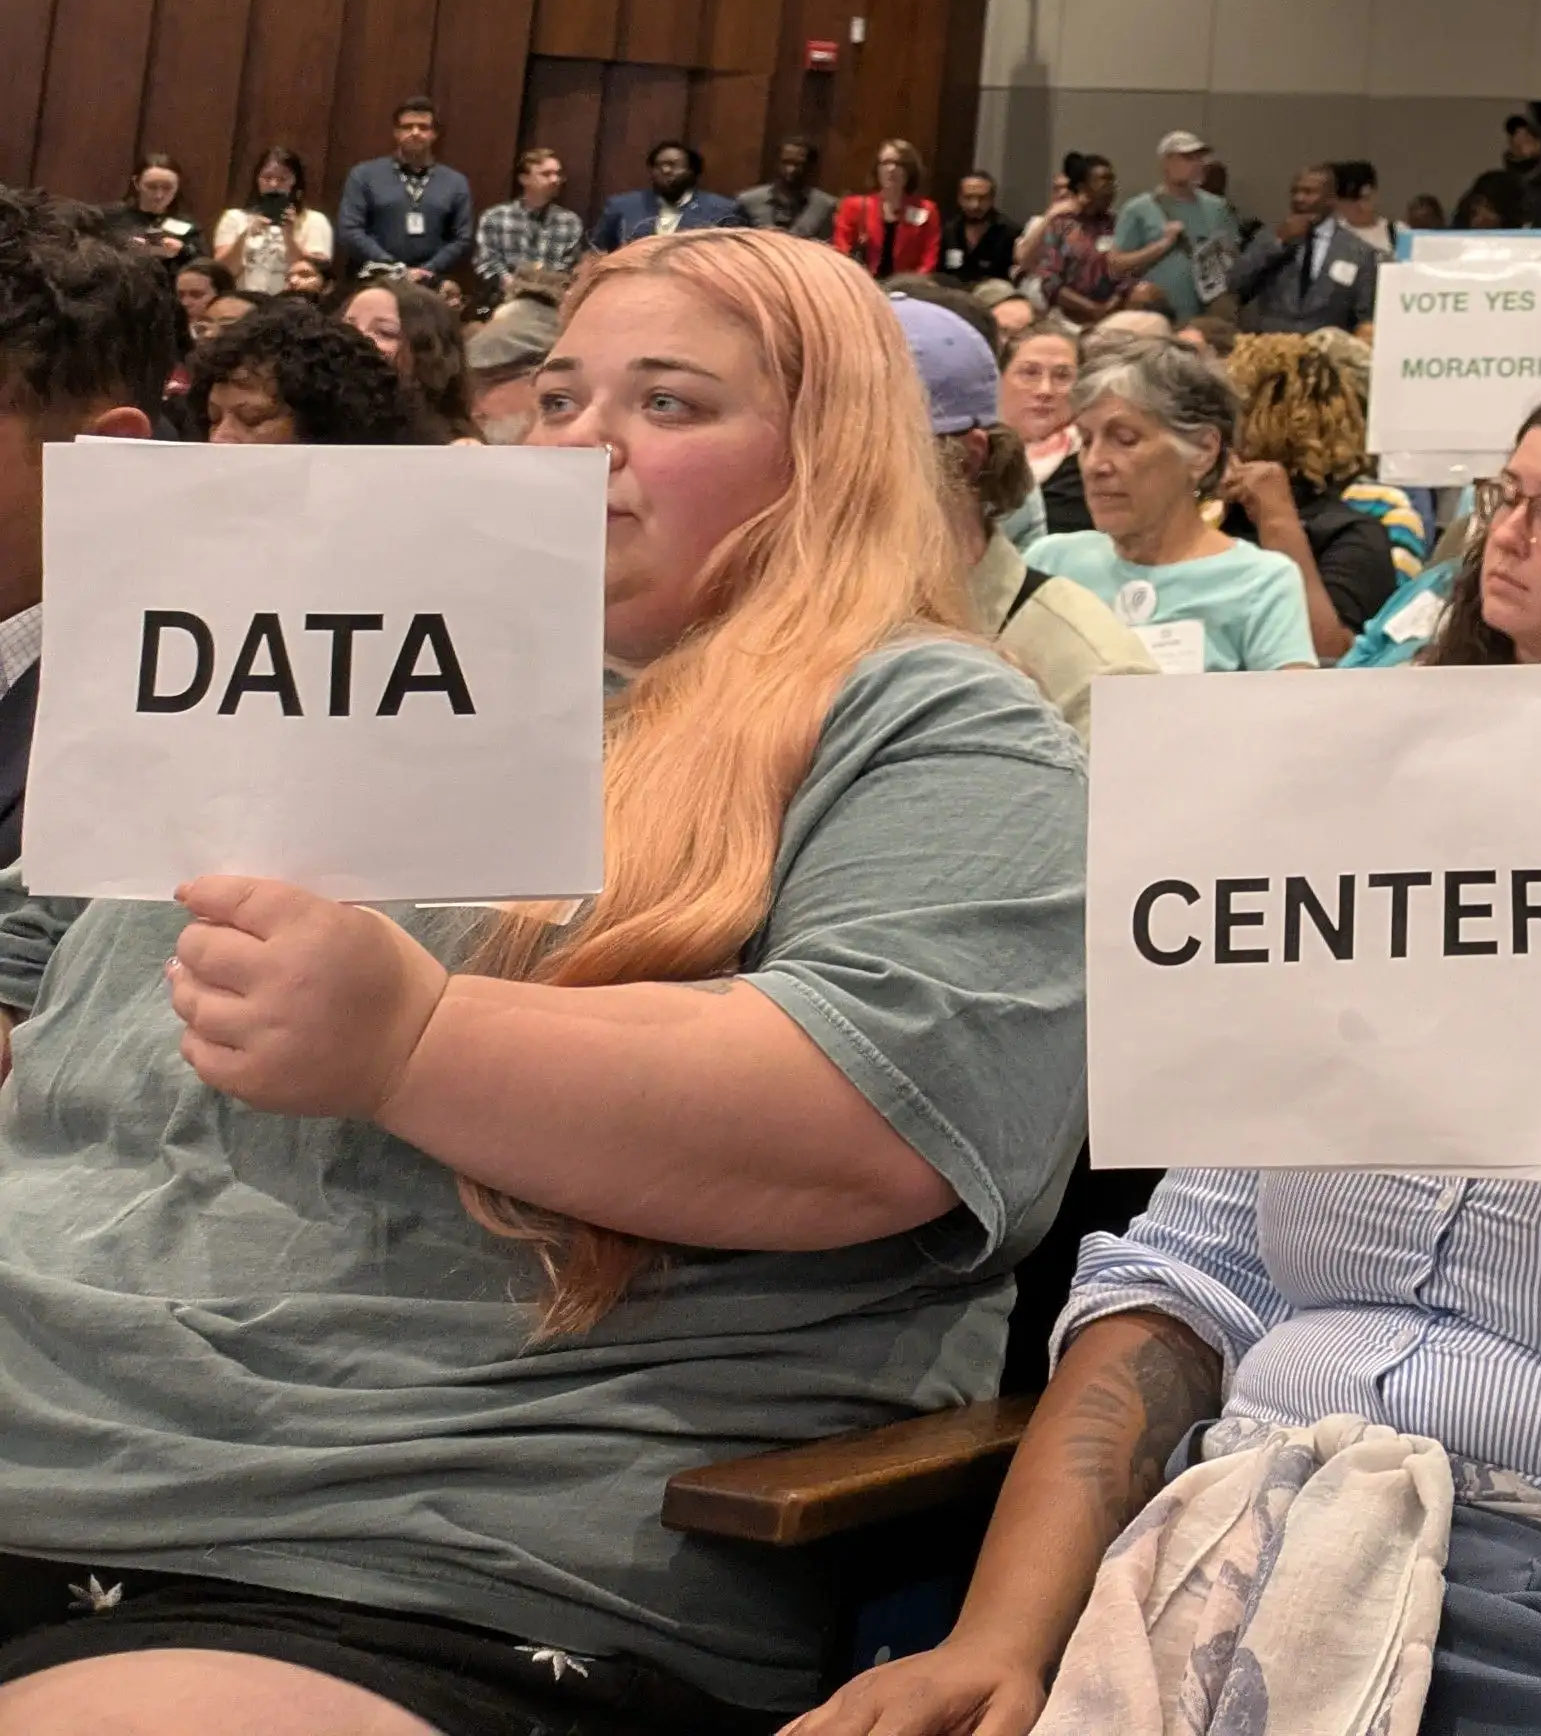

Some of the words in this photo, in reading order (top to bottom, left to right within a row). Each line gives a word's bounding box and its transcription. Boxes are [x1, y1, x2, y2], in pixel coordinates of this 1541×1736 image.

[1400, 292, 1469, 313] VOTE
[1486, 291, 1536, 311] YES
[135, 609, 477, 717] DATA
